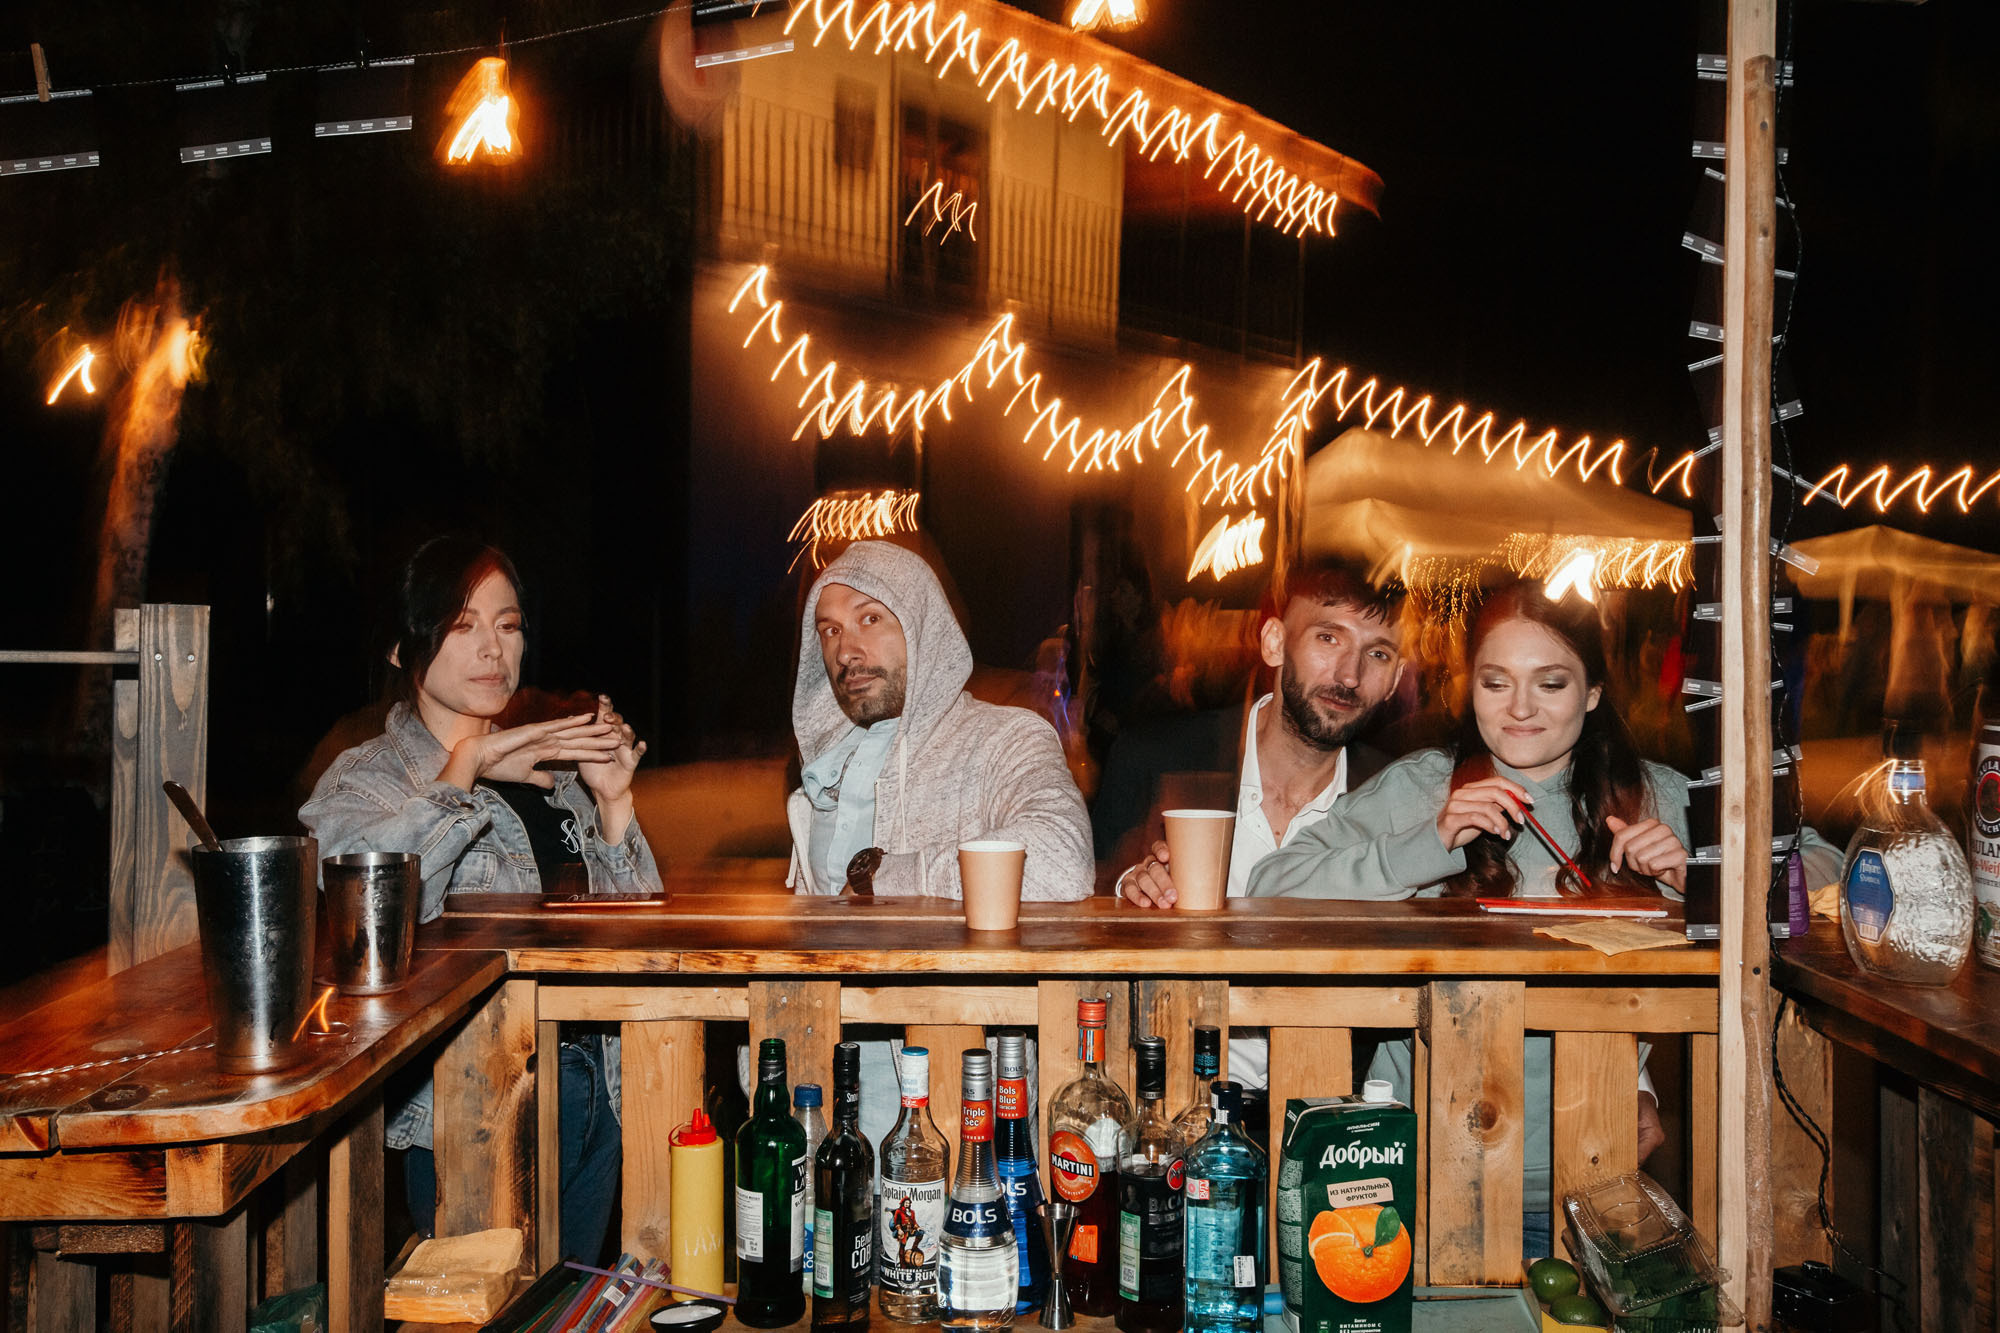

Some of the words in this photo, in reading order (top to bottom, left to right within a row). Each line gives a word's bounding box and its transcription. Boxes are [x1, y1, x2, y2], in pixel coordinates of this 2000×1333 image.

[999, 1085, 1016, 1095] Bols
[999, 1095, 1016, 1104] Blue
[963, 1106, 986, 1118] Triple
[964, 1117, 980, 1127] Sec
[1319, 1140, 1403, 1169] Добрый
[1051, 1153, 1093, 1177] MARTINI
[882, 1183, 907, 1201] Captain
[910, 1187, 941, 1203] Morgan
[1340, 1182, 1390, 1195] НАТУРАЛЬНЫХ
[1346, 1192, 1378, 1201] ФРУКТОВ
[951, 1207, 998, 1225] BOLS
[885, 1268, 912, 1281] WHITE
[915, 1270, 937, 1281] RUM
